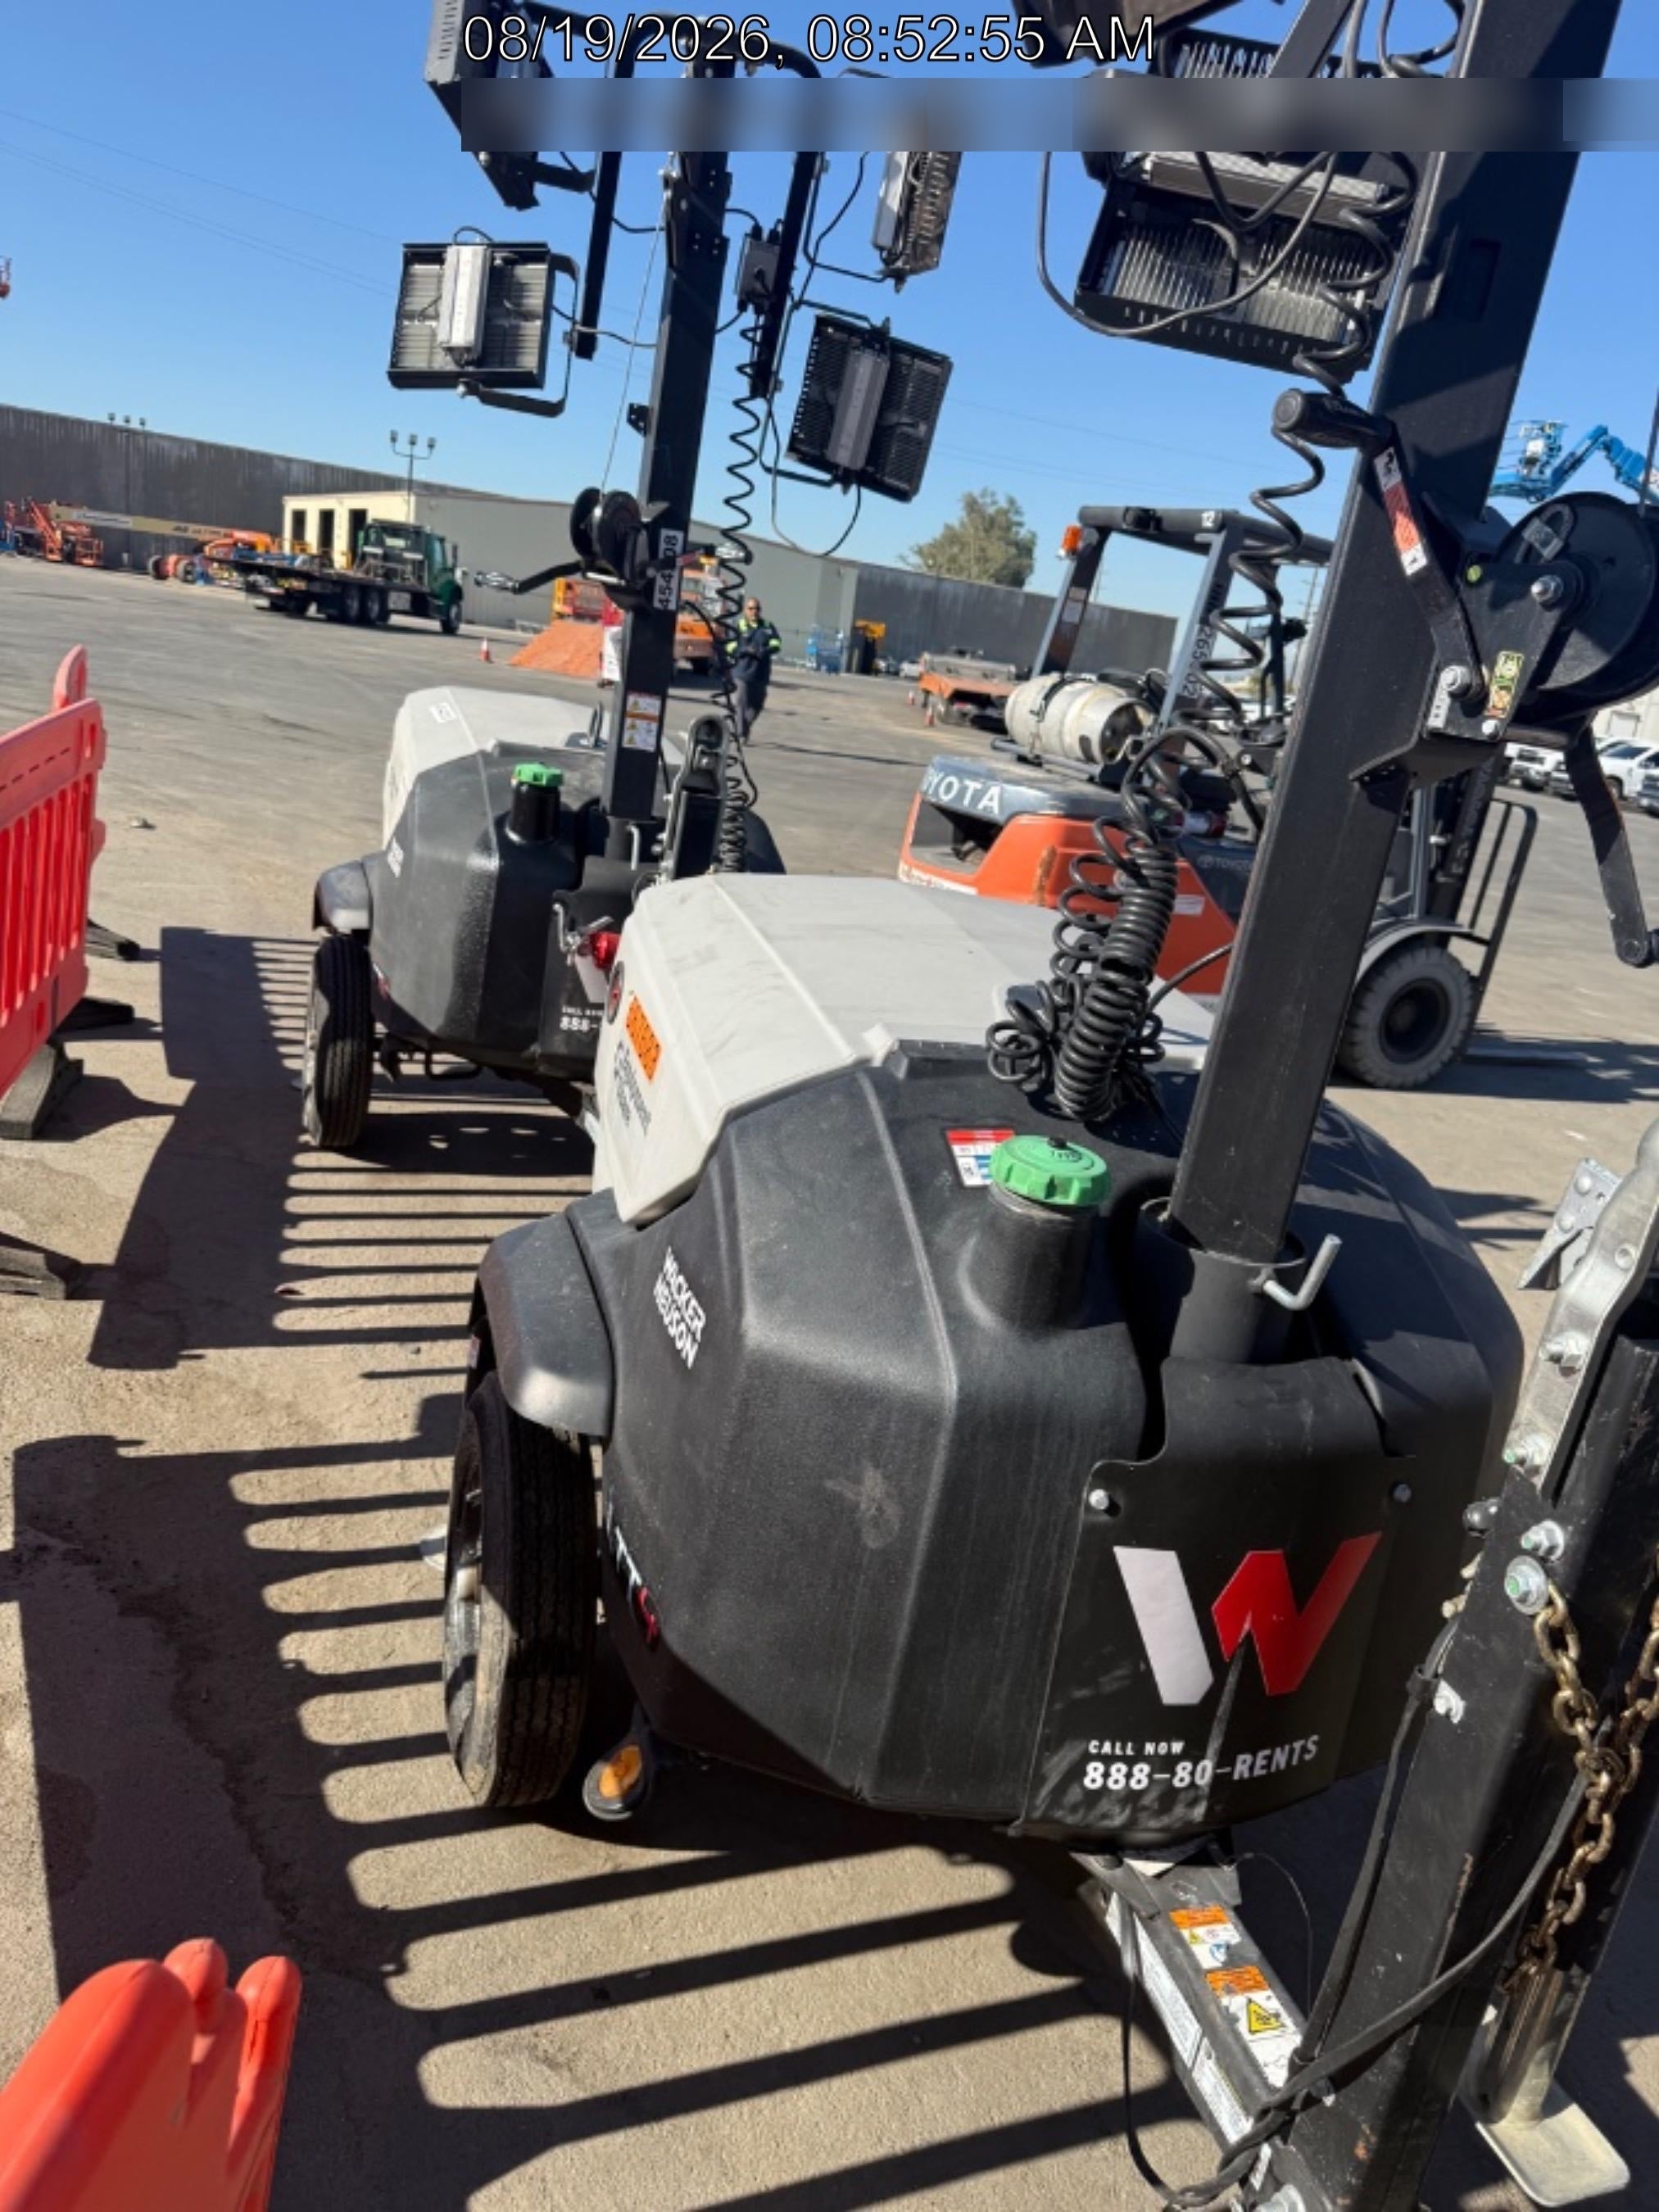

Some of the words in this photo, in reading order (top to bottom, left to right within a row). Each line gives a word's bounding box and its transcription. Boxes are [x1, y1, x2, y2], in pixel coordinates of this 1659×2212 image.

[922, 767, 1000, 816] YOTA
[664, 1244, 706, 1344] WACKER
[1083, 1734, 1320, 1790] 888-80-RENTS
[1088, 1739, 1135, 1756] CALL
[1144, 1740, 1185, 1756] NOW
